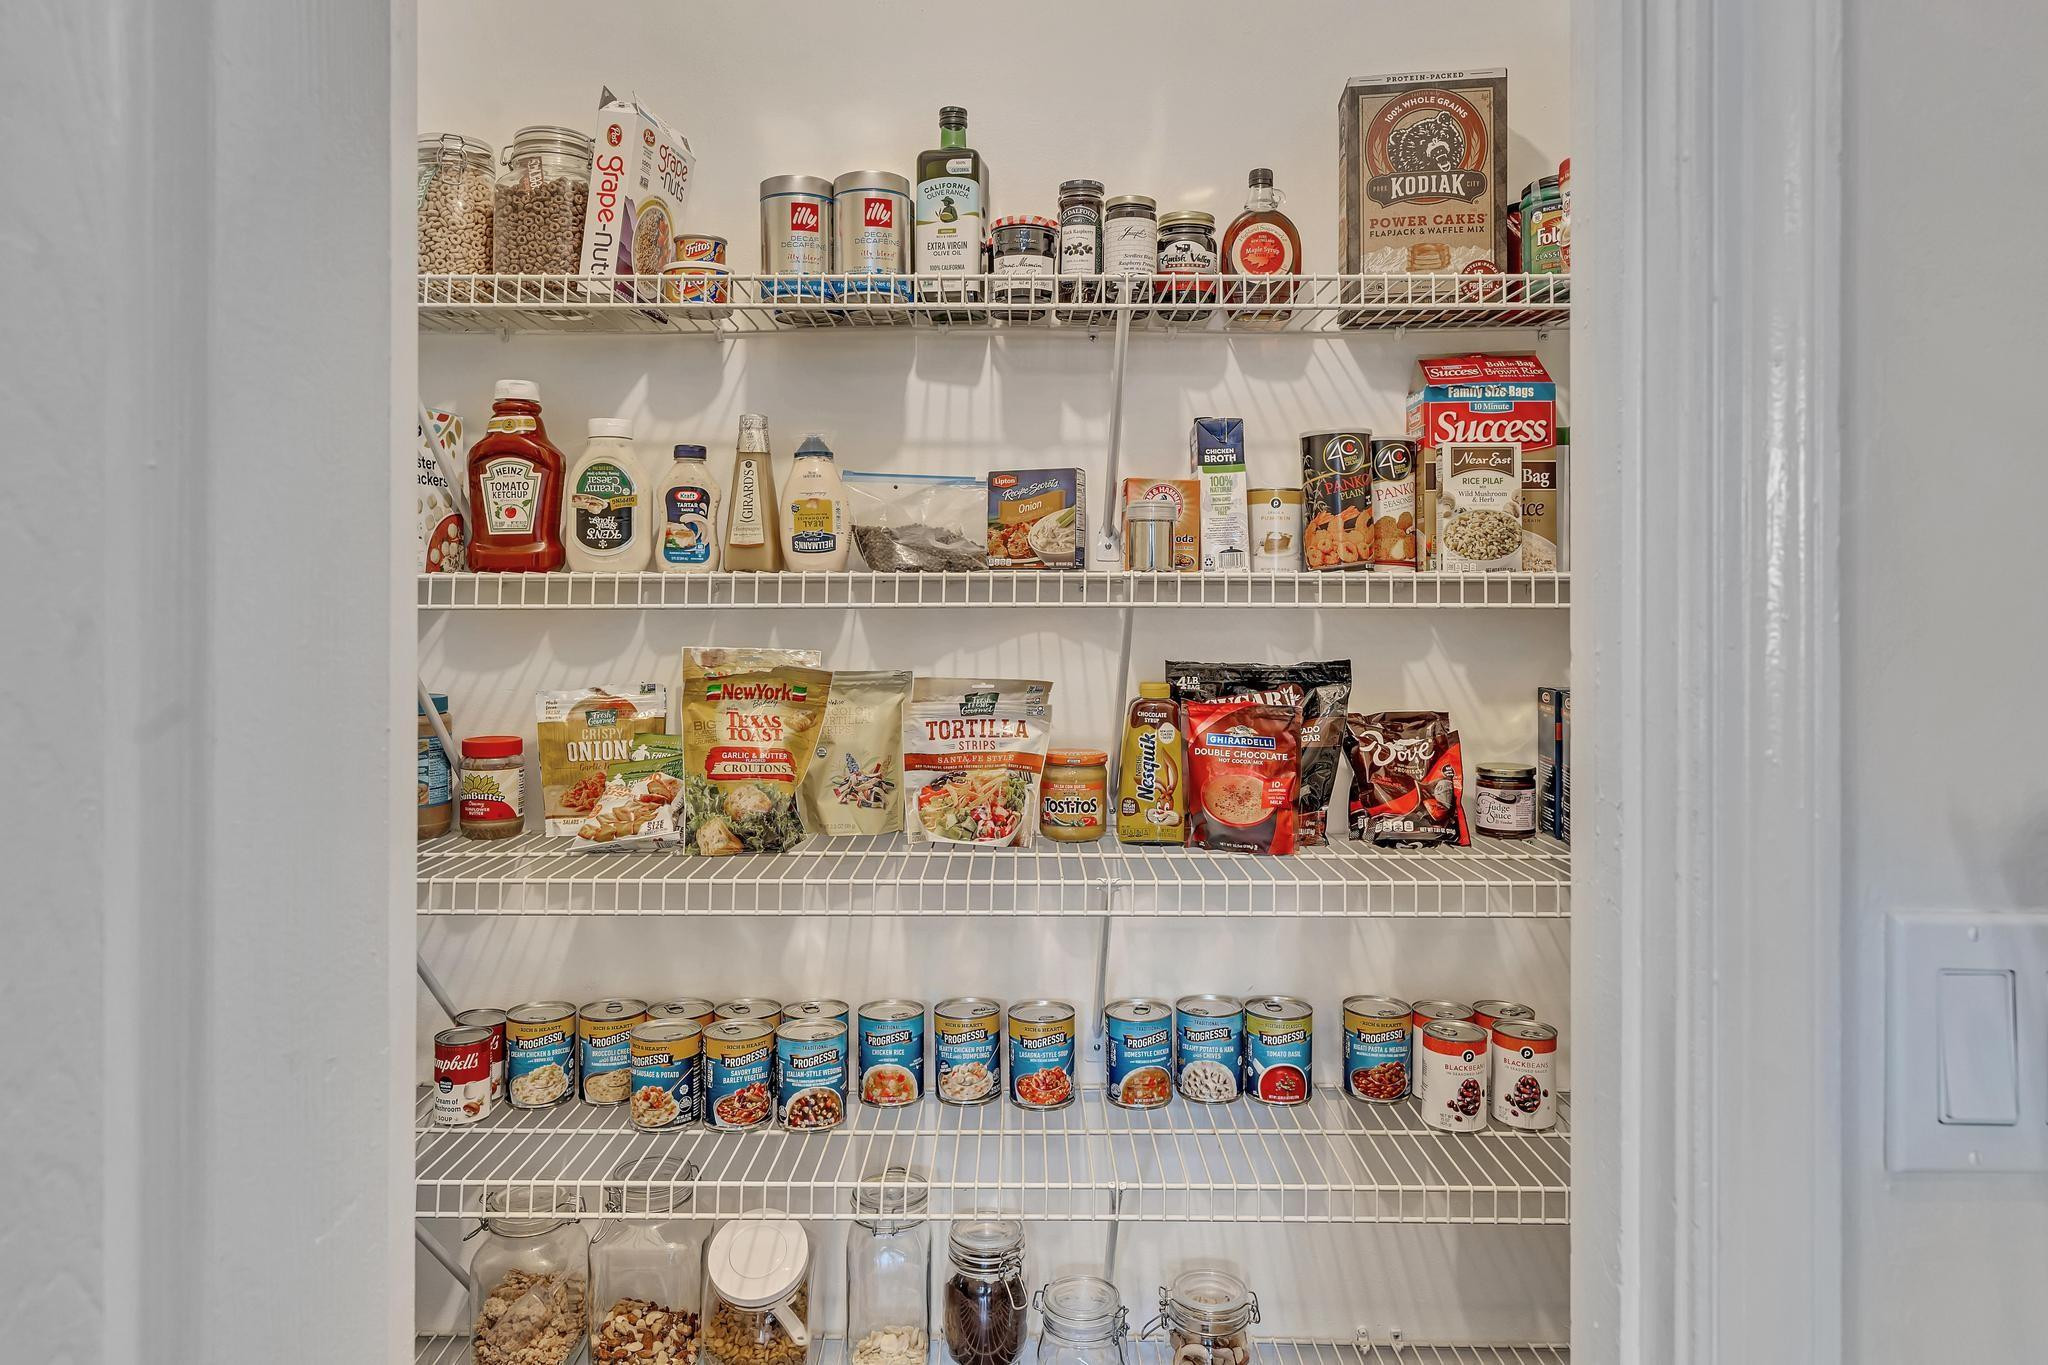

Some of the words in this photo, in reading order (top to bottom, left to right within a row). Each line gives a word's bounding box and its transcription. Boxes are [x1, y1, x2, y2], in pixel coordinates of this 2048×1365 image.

[1386, 71, 1464, 83] PROTEIN-PACKED
[1385, 106, 1402, 123] 100%
[1402, 96, 1435, 109] WHOLE
[1437, 97, 1468, 119] GRAINS
[658, 144, 688, 182] grape
[924, 182, 971, 194] CALIFORNIA
[1391, 174, 1466, 199] KODIAK
[926, 189, 946, 200] OLIVE
[945, 188, 968, 199] RANCH
[591, 154, 625, 276] grape-nut
[792, 207, 817, 229] illy
[866, 202, 891, 224] illy
[1370, 216, 1427, 229] POWER
[1433, 213, 1486, 225] CAKES
[1370, 229, 1416, 238] FLAPJACK
[1428, 226, 1464, 234] WAFFLE
[1467, 225, 1485, 233] MIX
[927, 242, 946, 251] EXTRA
[947, 241, 968, 250] VIRGIN
[1161, 253, 1186, 264] Amish
[1190, 251, 1211, 267] Valley
[941, 263, 965, 271] CALIFORNIA
[1430, 367, 1479, 378] Success
[1483, 367, 1519, 377] Brown
[1521, 367, 1544, 375] Rice
[1448, 386, 1483, 399] Family
[1485, 385, 1506, 399] Size
[1509, 385, 1534, 398] Bags
[1483, 403, 1510, 411] Minute
[1434, 411, 1548, 443] Success
[1204, 454, 1236, 463] BROTH
[1327, 440, 1357, 471] 4C
[1454, 452, 1489, 467] Near
[1489, 452, 1513, 468] East
[1378, 448, 1406, 478] 4C
[495, 467, 524, 476] HEINZ
[1522, 468, 1550, 487] Bag
[490, 481, 529, 492] TOMATO
[588, 476, 620, 485] Caesar
[1210, 476, 1233, 486] 100%
[1324, 473, 1370, 495] PANKO
[492, 491, 528, 499] KETCHUP
[584, 483, 622, 494] Creamy
[742, 470, 754, 520] GIRARD'S
[1340, 488, 1364, 500] PLAIN
[1376, 481, 1415, 501] PANKO
[1019, 500, 1042, 513] Onion
[803, 520, 824, 528] REAL
[586, 528, 622, 540] KEN'S
[794, 539, 834, 551] HELLMANN'S
[1177, 676, 1187, 690] 4
[693, 720, 716, 730] BIG
[726, 711, 782, 728] TEXAS
[582, 728, 623, 740] CRISPY
[727, 727, 783, 742] TOAST
[925, 719, 1029, 740] TORTILLA
[958, 740, 996, 750] STRIPS
[1209, 735, 1274, 747] GHIRARDELLI
[1195, 748, 1231, 757] DOUBLE
[1233, 750, 1289, 761] CHOCOLATE
[1359, 730, 1435, 766] Dove
[937, 756, 969, 764] SANTA
[986, 754, 1015, 762] STYLE
[724, 764, 787, 773] CROUTONS
[1137, 733, 1160, 801] Nesquik
[460, 791, 505, 802] SunButter
[1482, 799, 1510, 814] Fudge
[1486, 811, 1511, 823] Sauce
[519, 1032, 562, 1049] PROGRESSO
[868, 1032, 909, 1046] PROGRESSO
[944, 1030, 985, 1044] PROGRESSO
[1023, 1033, 1064, 1049] PROGRESSO
[1127, 1031, 1167, 1048] PROGRESSO
[1187, 1029, 1228, 1041] PROGRESSO
[1262, 1030, 1304, 1045] PROGRESSO
[1360, 1030, 1403, 1043] PROGRESSO
[725, 1049, 767, 1067] PROGRESSO
[793, 1051, 837, 1068] PROGRESSO
[731, 1068, 751, 1076] SAVORY
[452, 1097, 458, 1105] of
